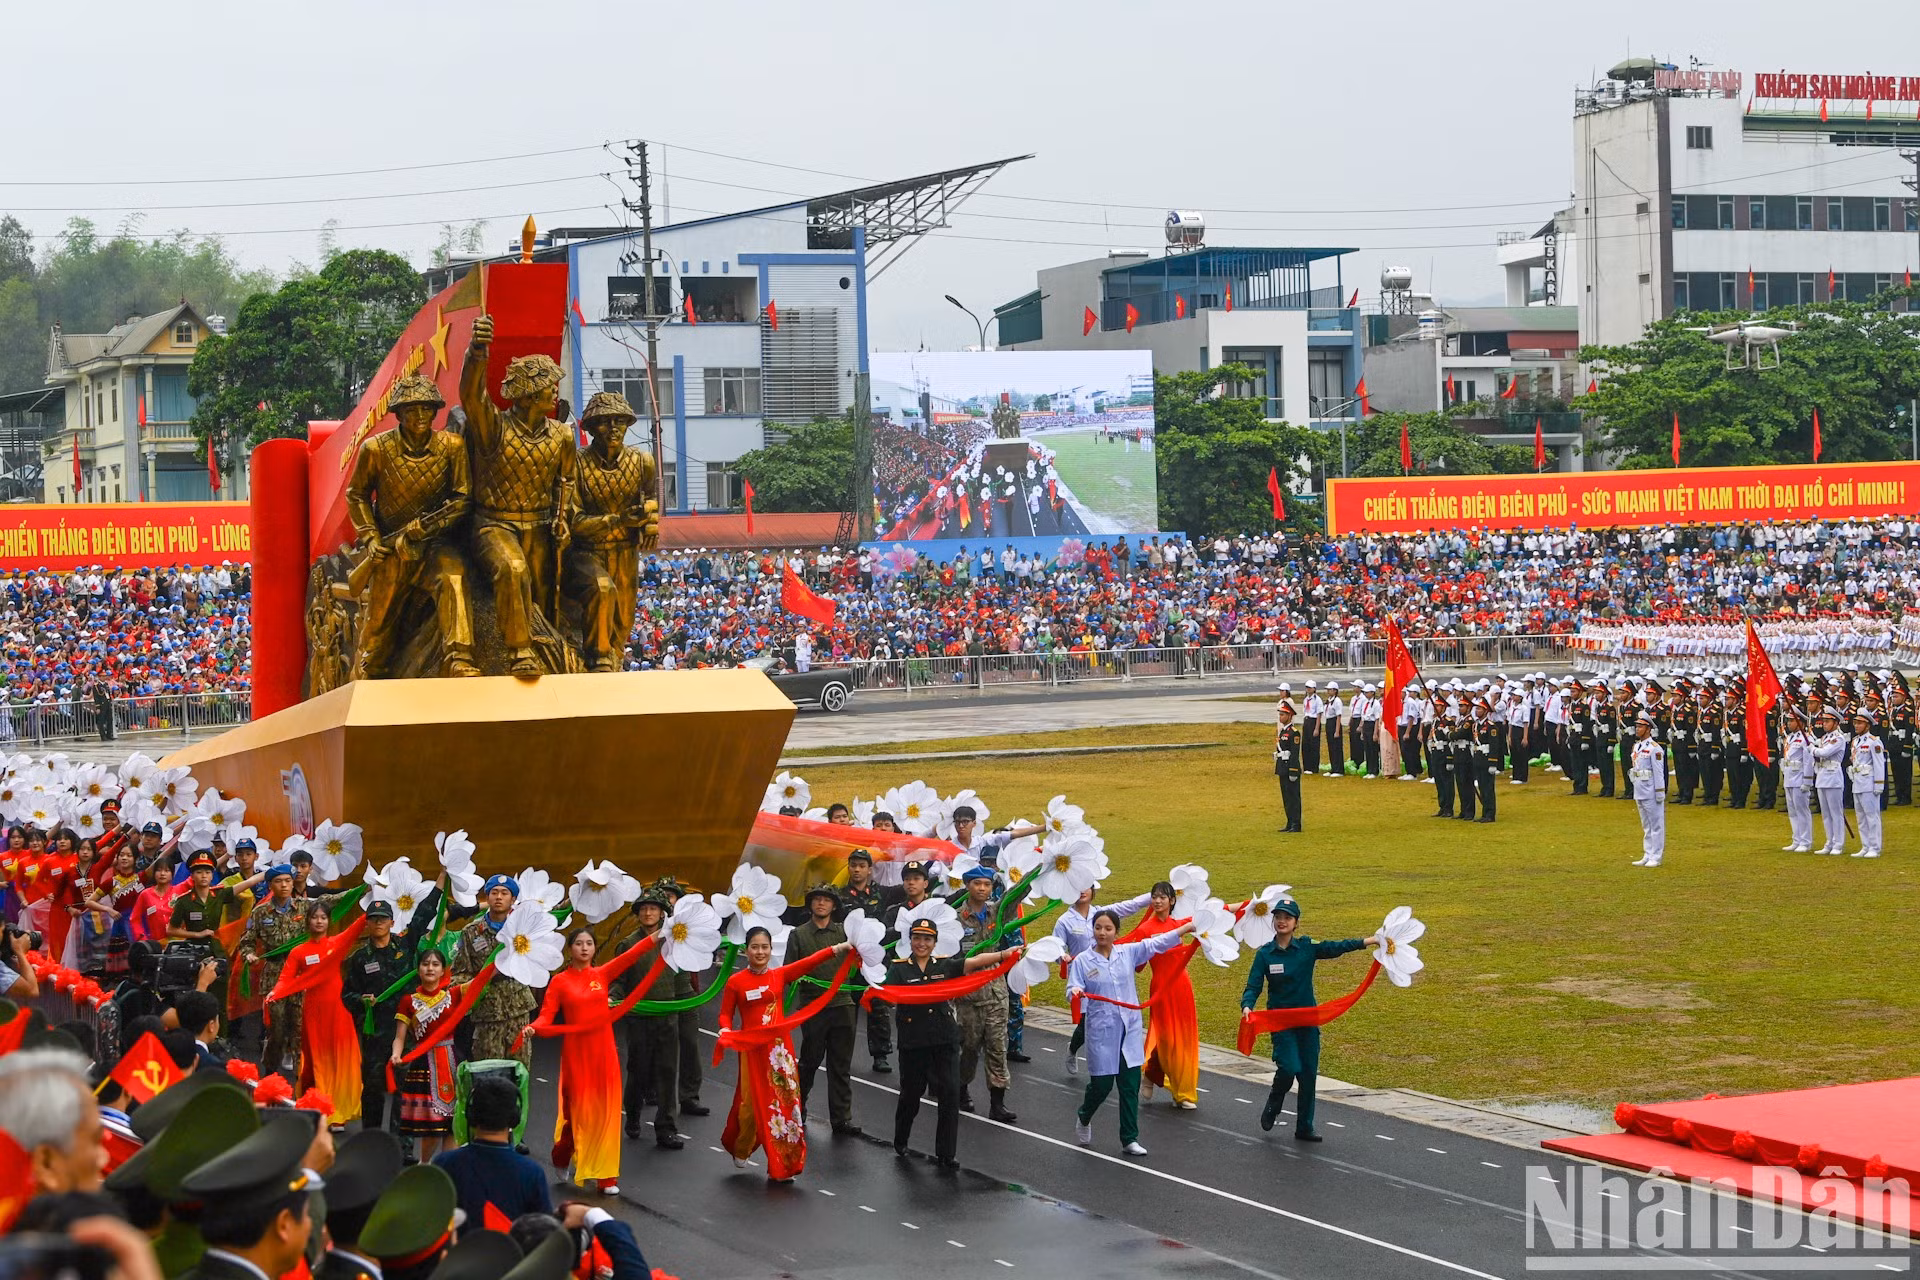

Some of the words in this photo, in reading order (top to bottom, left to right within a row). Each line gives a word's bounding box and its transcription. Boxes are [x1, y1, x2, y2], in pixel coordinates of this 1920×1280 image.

[1755, 69, 1807, 98] KHÁCH
[1845, 71, 1896, 100] HOÀNG
[1363, 490, 1407, 521] CHIẾN
[1410, 488, 1459, 520] THẮNG
[1461, 490, 1497, 524] ĐIỆN
[1500, 489, 1534, 518] BIÊN
[1538, 485, 1568, 517] PHỦ
[1582, 486, 1611, 515] SỨC
[1615, 489, 1660, 518] MẠNH
[1663, 483, 1695, 517] VIỆT
[1698, 487, 1733, 511] NAM
[1736, 480, 1770, 509] THỜI
[1774, 484, 1800, 513] ĐẠI
[1803, 476, 1824, 508] HỒ
[1828, 478, 1854, 507] CHÍ
[41, 517, 89, 556] THẮNG
[92, 521, 127, 561] ĐIỆN
[129, 520, 165, 555] BIÊN
[168, 516, 199, 553] PHỦ
[211, 518, 251, 552] LỪNG
